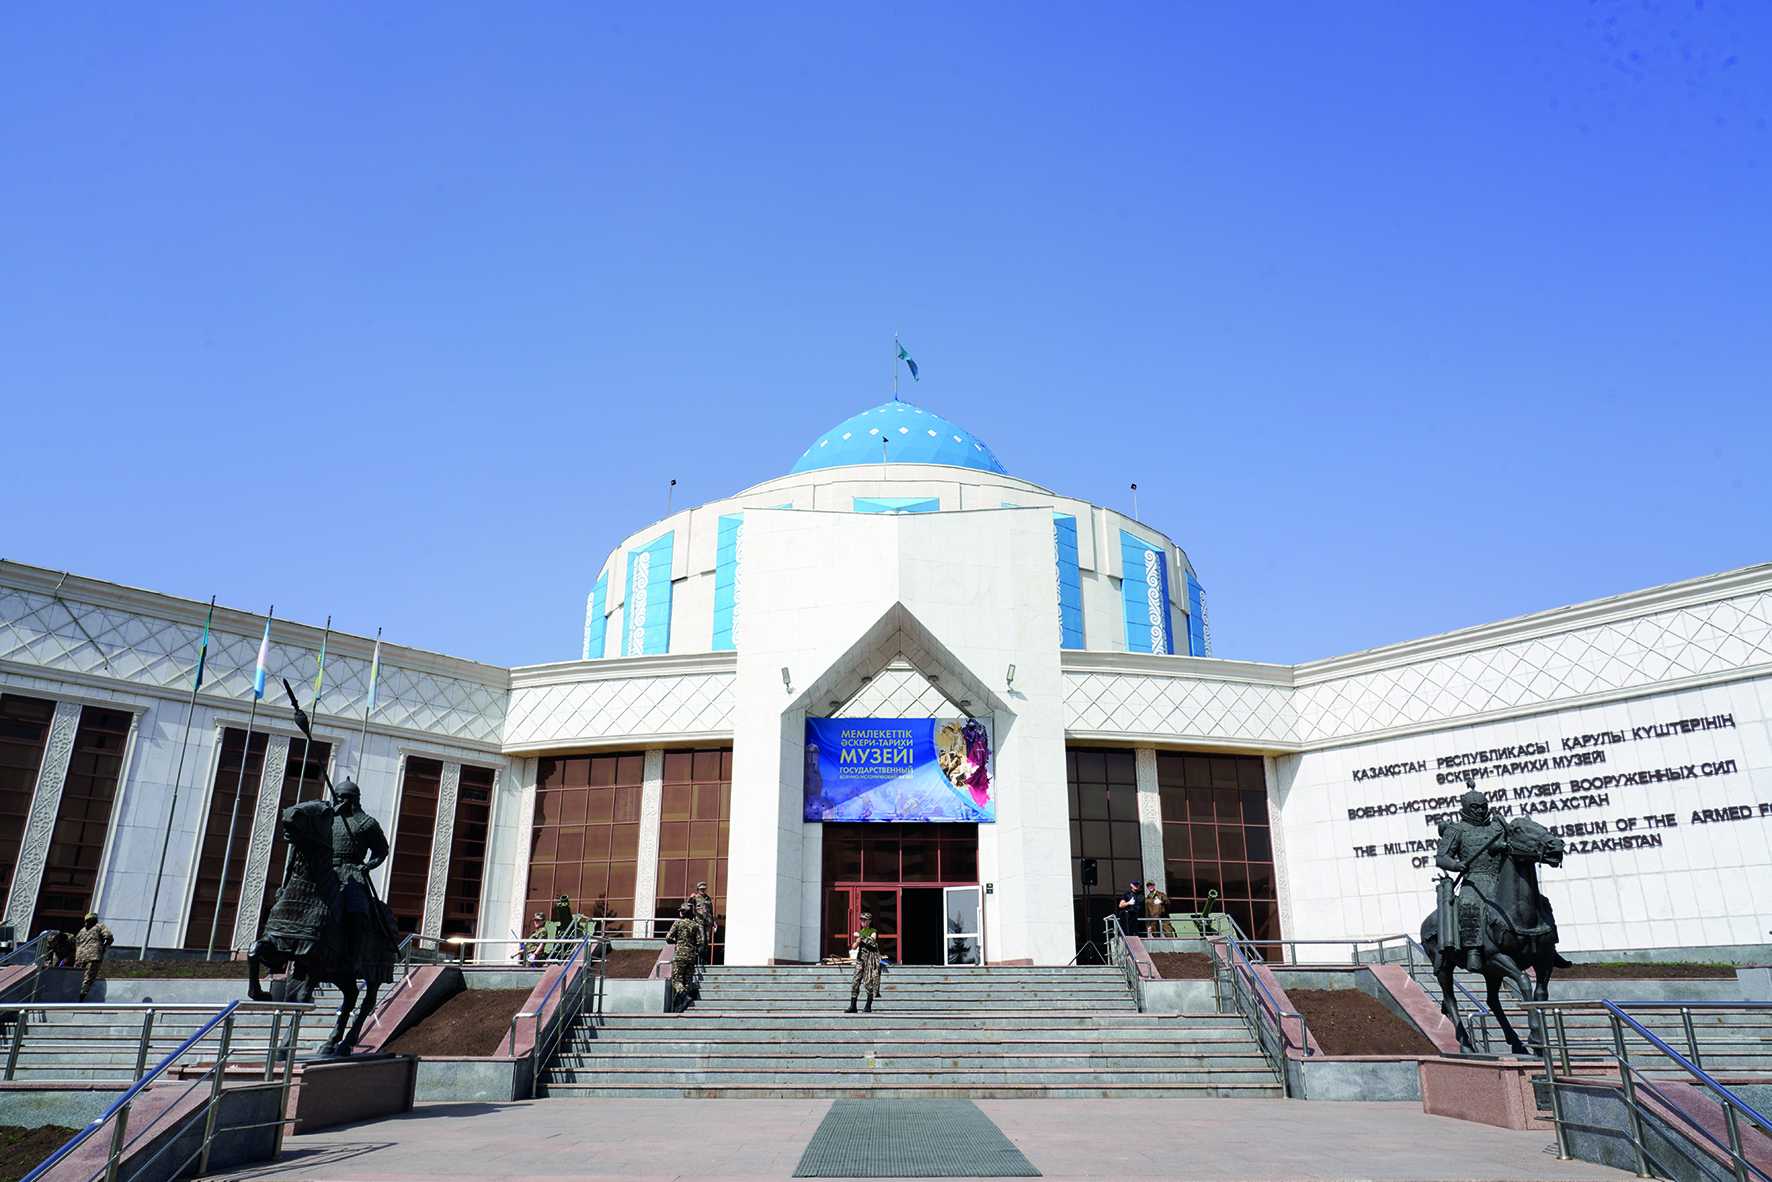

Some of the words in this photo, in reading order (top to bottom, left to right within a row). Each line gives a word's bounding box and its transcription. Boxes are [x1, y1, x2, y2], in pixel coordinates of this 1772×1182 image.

[841, 730, 912, 738] МЕМЛЕКЕТТІК
[840, 746, 913, 764] МУЗЕЙІ
[1352, 760, 1427, 783] ҚАЗАҚСТАН
[1437, 741, 1550, 769] РЕСПУБЛИКАСЫ
[1562, 730, 1626, 751] ҚАРУЛЫ
[840, 766, 913, 774] ГОСУДАРСТВЕННЫЙ
[1436, 758, 1549, 785] ӘСКЕРИ-ТАРИХИ
[1552, 750, 1606, 770] МУЗЕЙІ
[1513, 782, 1561, 800] МУЗЕЙ
[1570, 764, 1698, 793] ВООРУЖЕННЫХ
[1701, 759, 1738, 777] СИЛ
[1520, 793, 1610, 815] КАЗАХСТАН
[1353, 845, 1377, 858] THE
[1615, 818, 1637, 831] OF
[1644, 813, 1678, 828] THE
[1691, 805, 1752, 824] ARMED
[1411, 856, 1428, 868] OF
